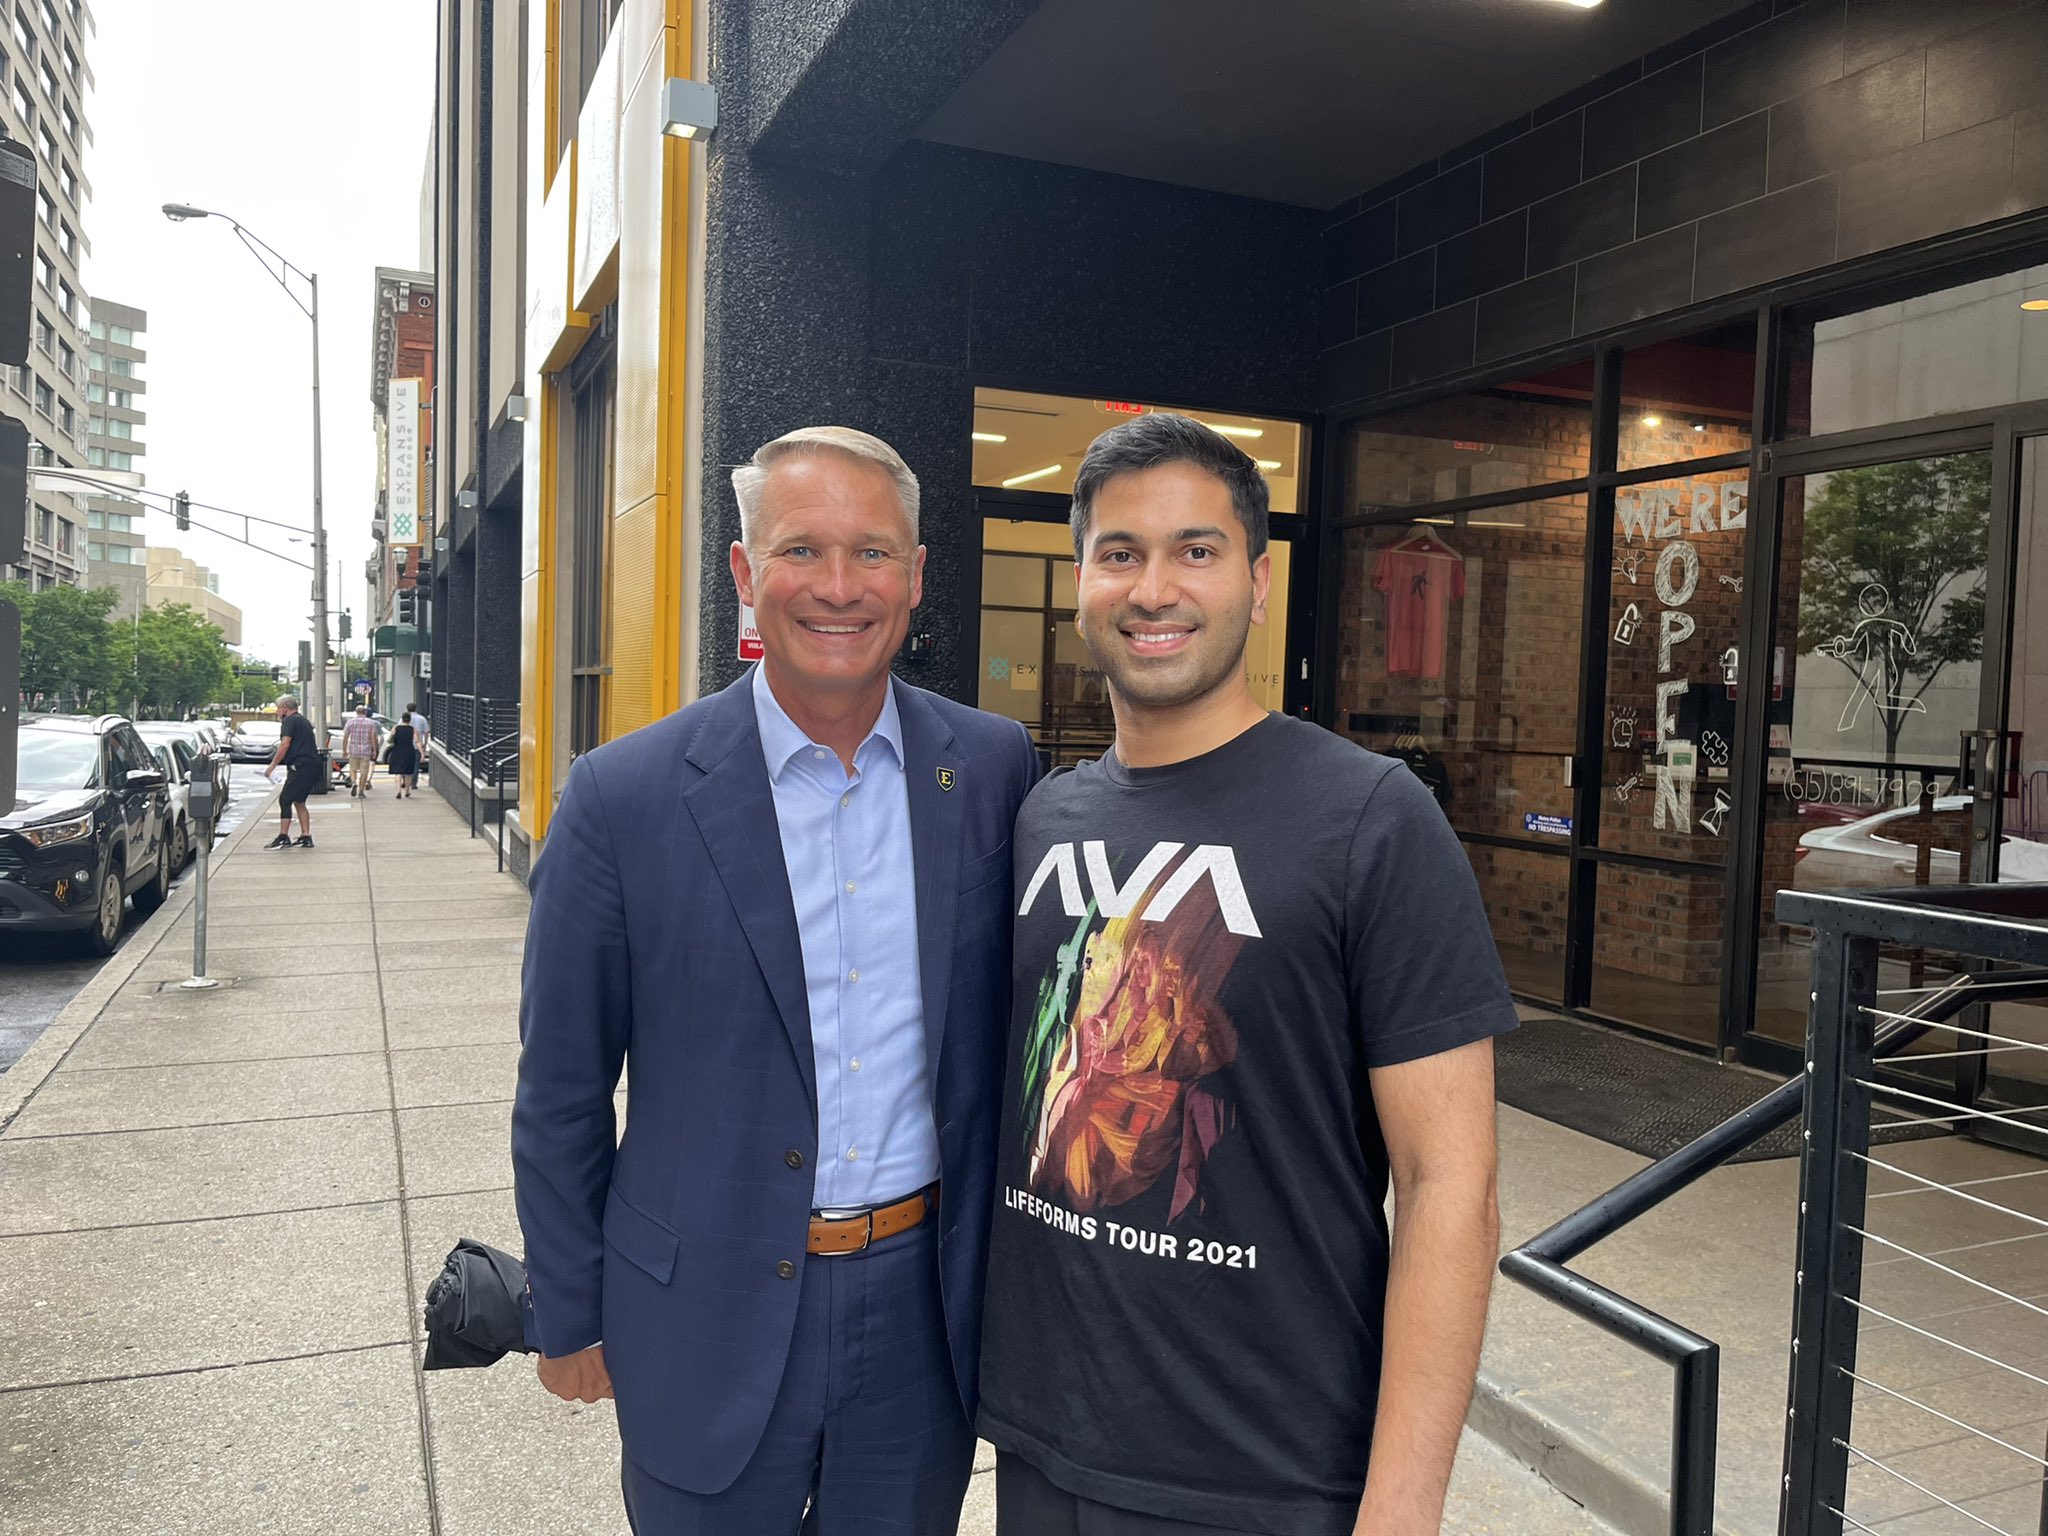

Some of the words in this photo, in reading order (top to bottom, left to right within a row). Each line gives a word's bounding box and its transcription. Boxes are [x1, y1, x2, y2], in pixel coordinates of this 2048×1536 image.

[396, 387, 406, 504] EXPANSIVE
[1615, 479, 1748, 543] WE'RE
[1653, 541, 1699, 834] OPEN
[1528, 823, 1537, 831] NO
[1537, 824, 1571, 836] TRESPASSING
[1005, 1185, 1097, 1240] LIFEFORMS
[1106, 1221, 1177, 1259] TOUR
[1187, 1238, 1256, 1269] 2021
